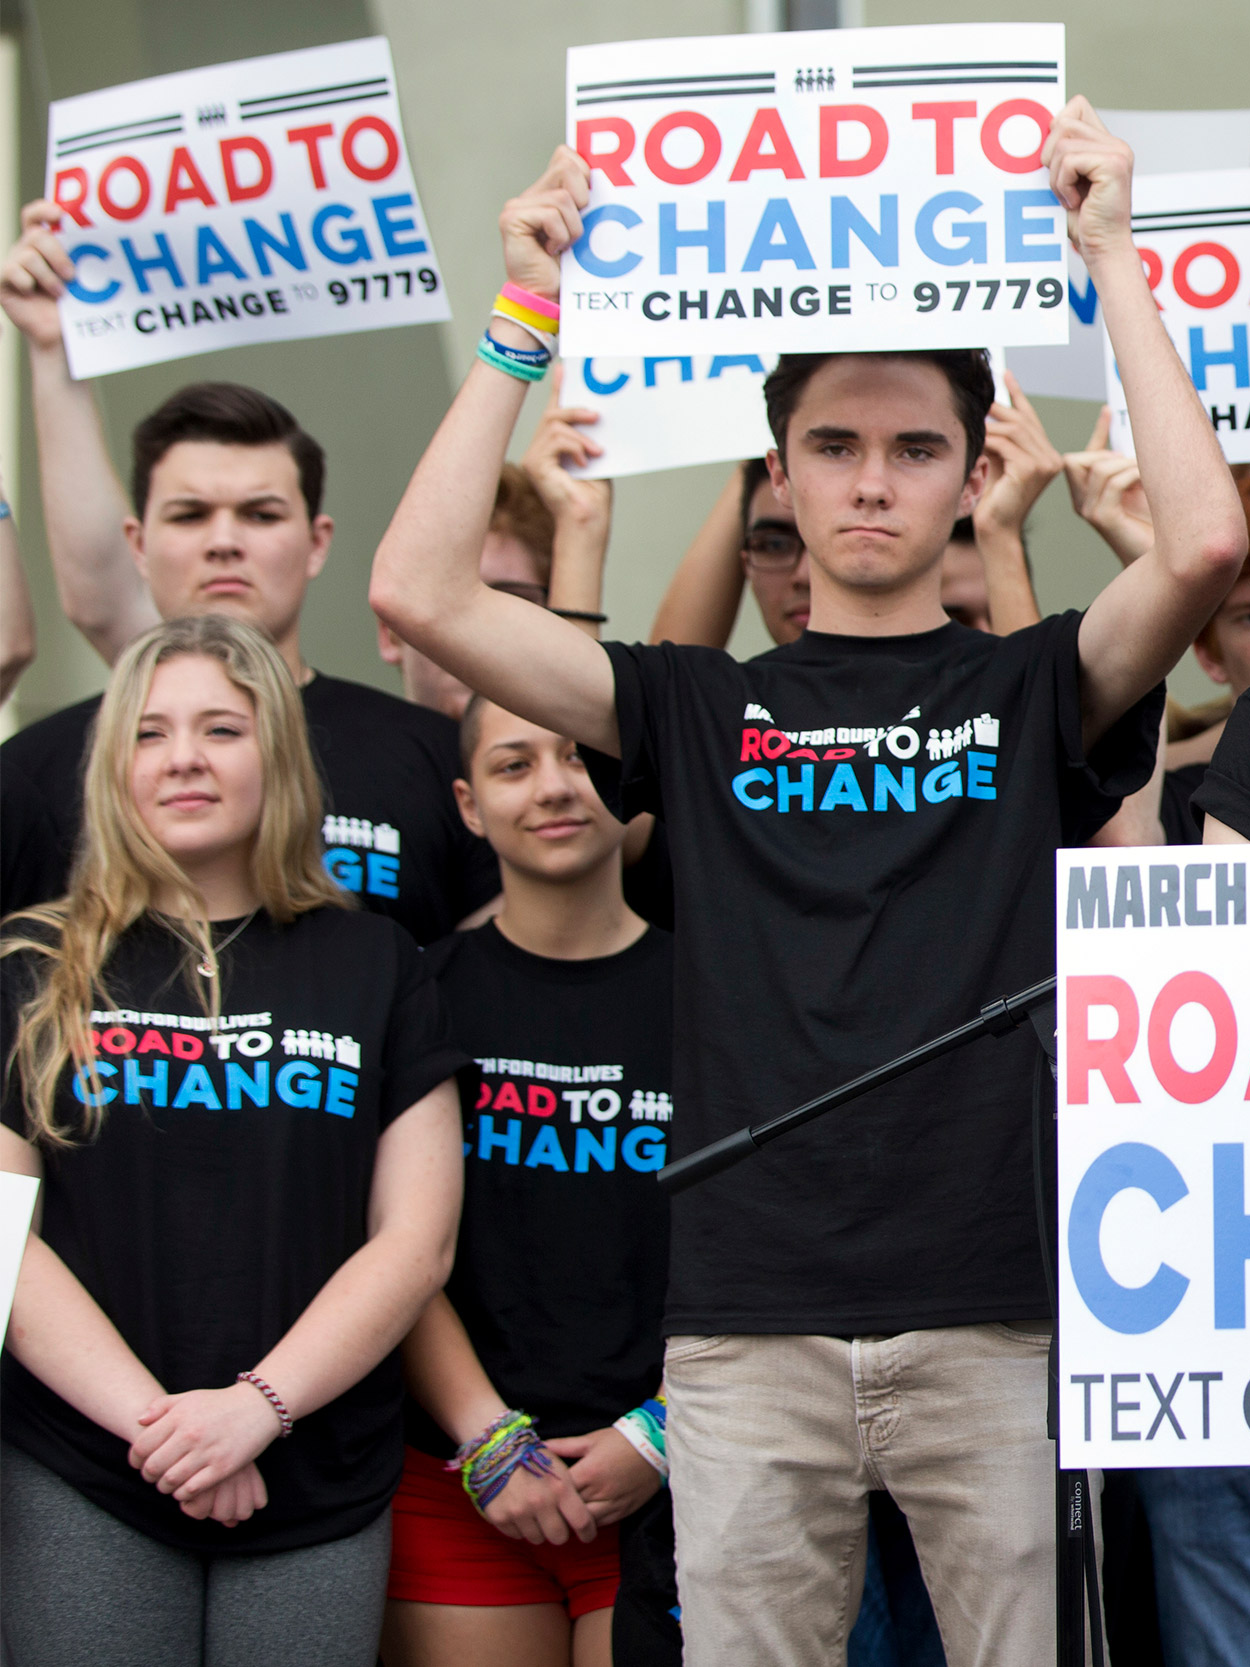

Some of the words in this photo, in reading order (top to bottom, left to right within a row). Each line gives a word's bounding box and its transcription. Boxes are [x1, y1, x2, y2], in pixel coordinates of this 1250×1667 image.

[575, 103, 889, 187] ROAD
[911, 99, 1053, 175] TO
[51, 135, 274, 234] ROAD
[286, 115, 400, 189] TO
[65, 193, 428, 304] CHANGE
[571, 190, 1063, 278] CHANGE
[75, 312, 126, 338] TEXT
[134, 289, 289, 335] CHANGE
[292, 282, 320, 301] TO
[327, 267, 440, 306] 97779
[573, 290, 634, 311] TEXT
[642, 284, 852, 321] CHANGE
[866, 282, 897, 301] TO
[913, 277, 1064, 313] 97779
[739, 728, 857, 762] ROAD
[731, 750, 998, 813] CHANGE
[90, 1009, 140, 1025] ARCH
[141, 1012, 179, 1028] FOR
[218, 1011, 273, 1030] LIVES
[208, 1030, 274, 1061] TO
[72, 1058, 359, 1119] CHANGE
[498, 1057, 535, 1078] FOR
[534, 1062, 574, 1084] OUR
[573, 1064, 624, 1084] LIVES
[561, 1088, 622, 1124] TO
[463, 1114, 668, 1174] HANG
[1071, 1370, 1223, 1442] TEXT
[1075, 1481, 1083, 1530] connect
